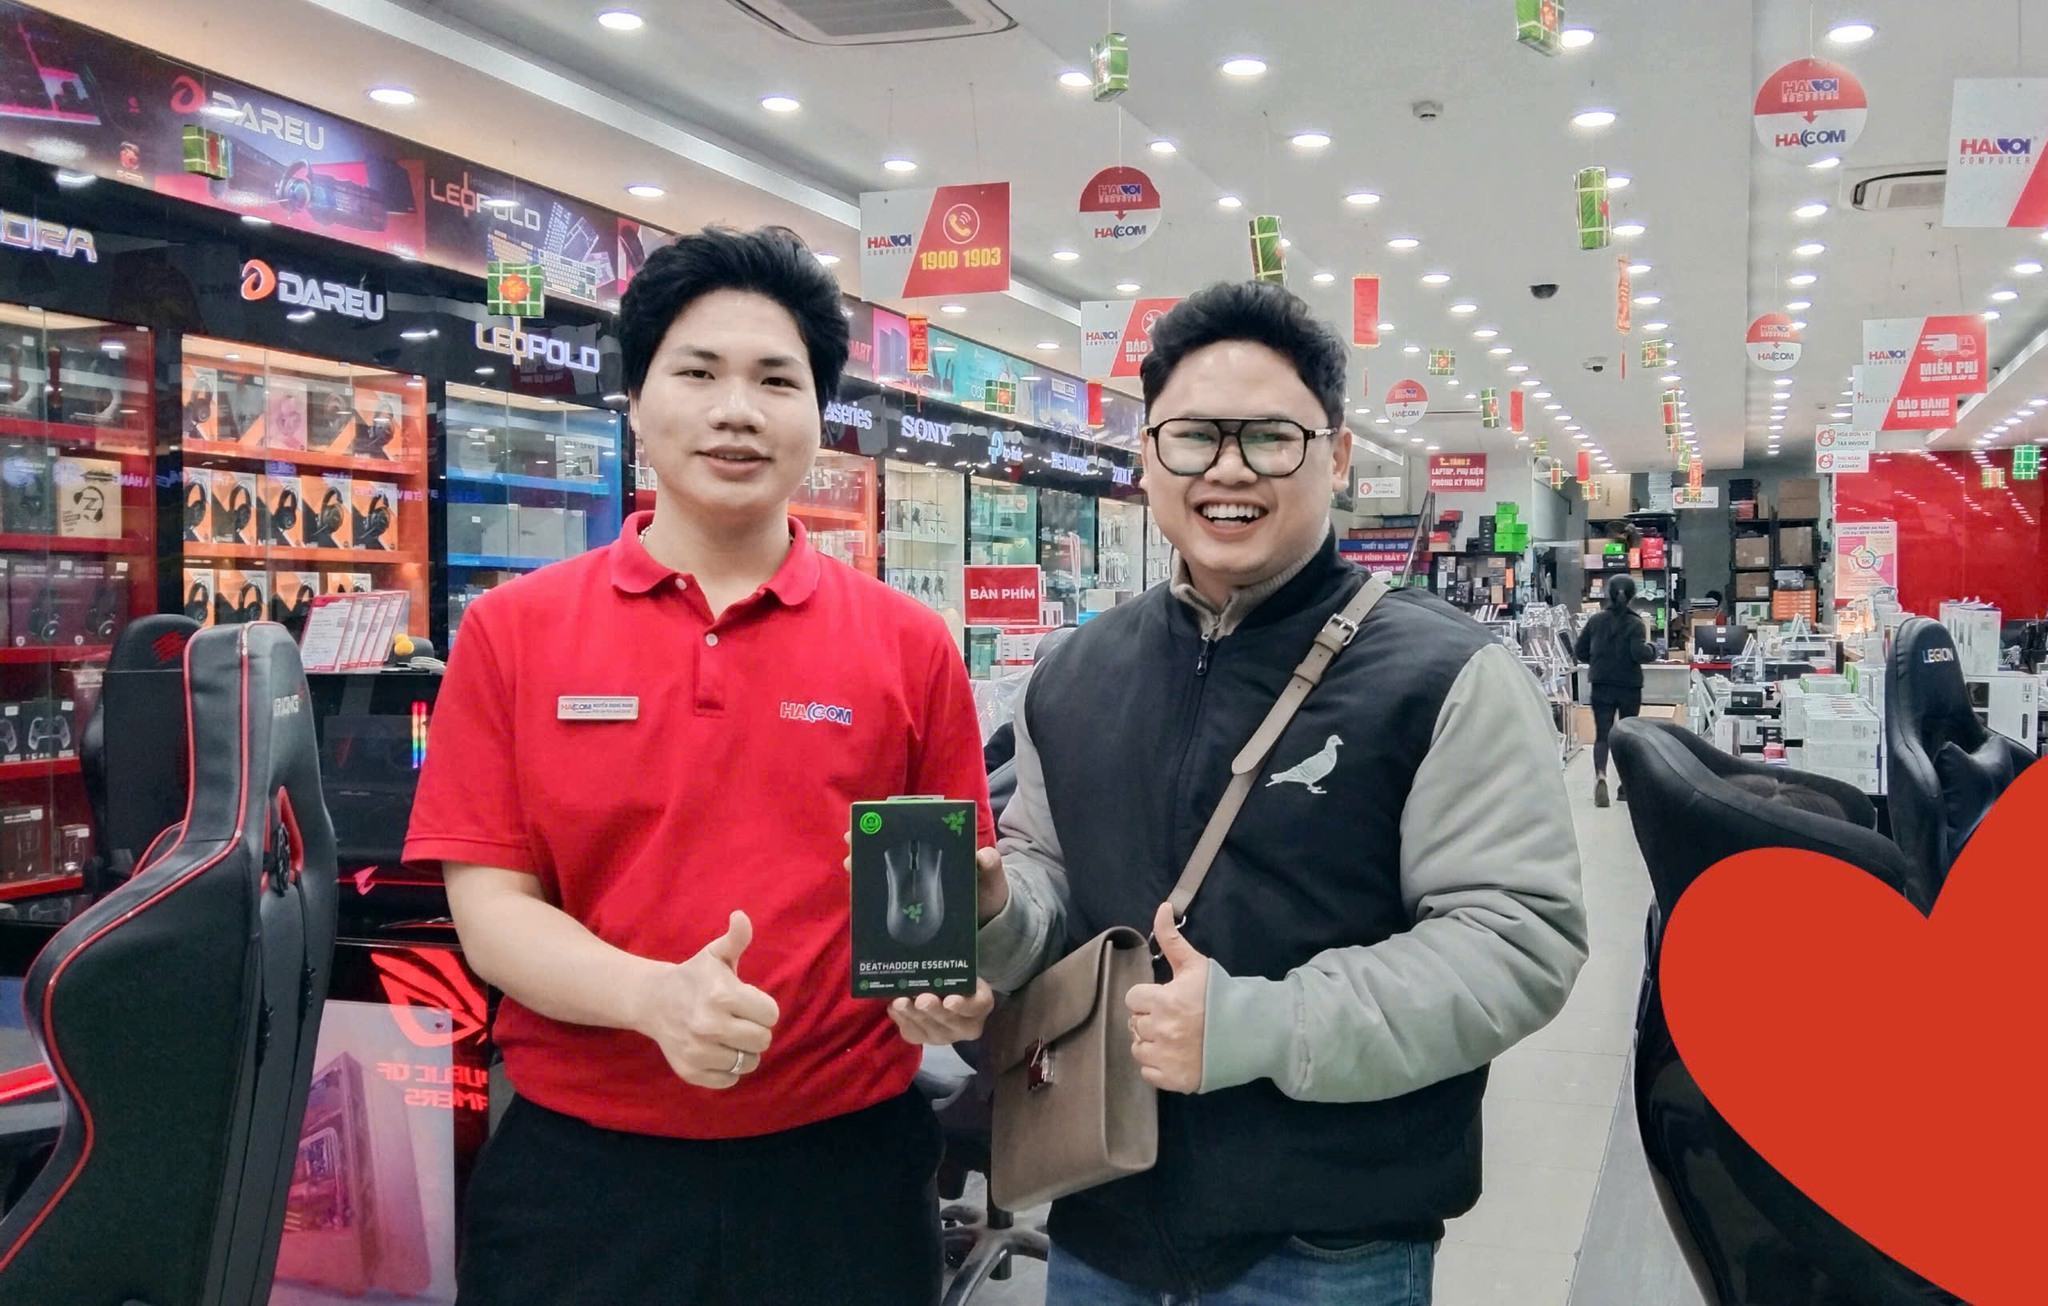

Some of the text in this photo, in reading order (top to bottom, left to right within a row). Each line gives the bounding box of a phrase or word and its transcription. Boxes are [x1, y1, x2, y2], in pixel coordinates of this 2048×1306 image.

[211, 90, 324, 151] DAREU
[1959, 156, 2031, 165] COMPUTER
[431, 171, 541, 231] LEOPOLD
[920, 247, 1002, 270] 1900 1903
[279, 273, 384, 321] DAREU
[474, 316, 600, 374] LEOPOLD
[1920, 359, 1979, 376] MIỄN PHÍ
[1896, 396, 1950, 410] BẢO HÀNH
[901, 415, 952, 446] SONY
[970, 586, 1036, 600] BÀN PHÍM
[1922, 648, 1954, 664] LEGION
[860, 960, 969, 972] DEATHADDER ESSENTIAL
